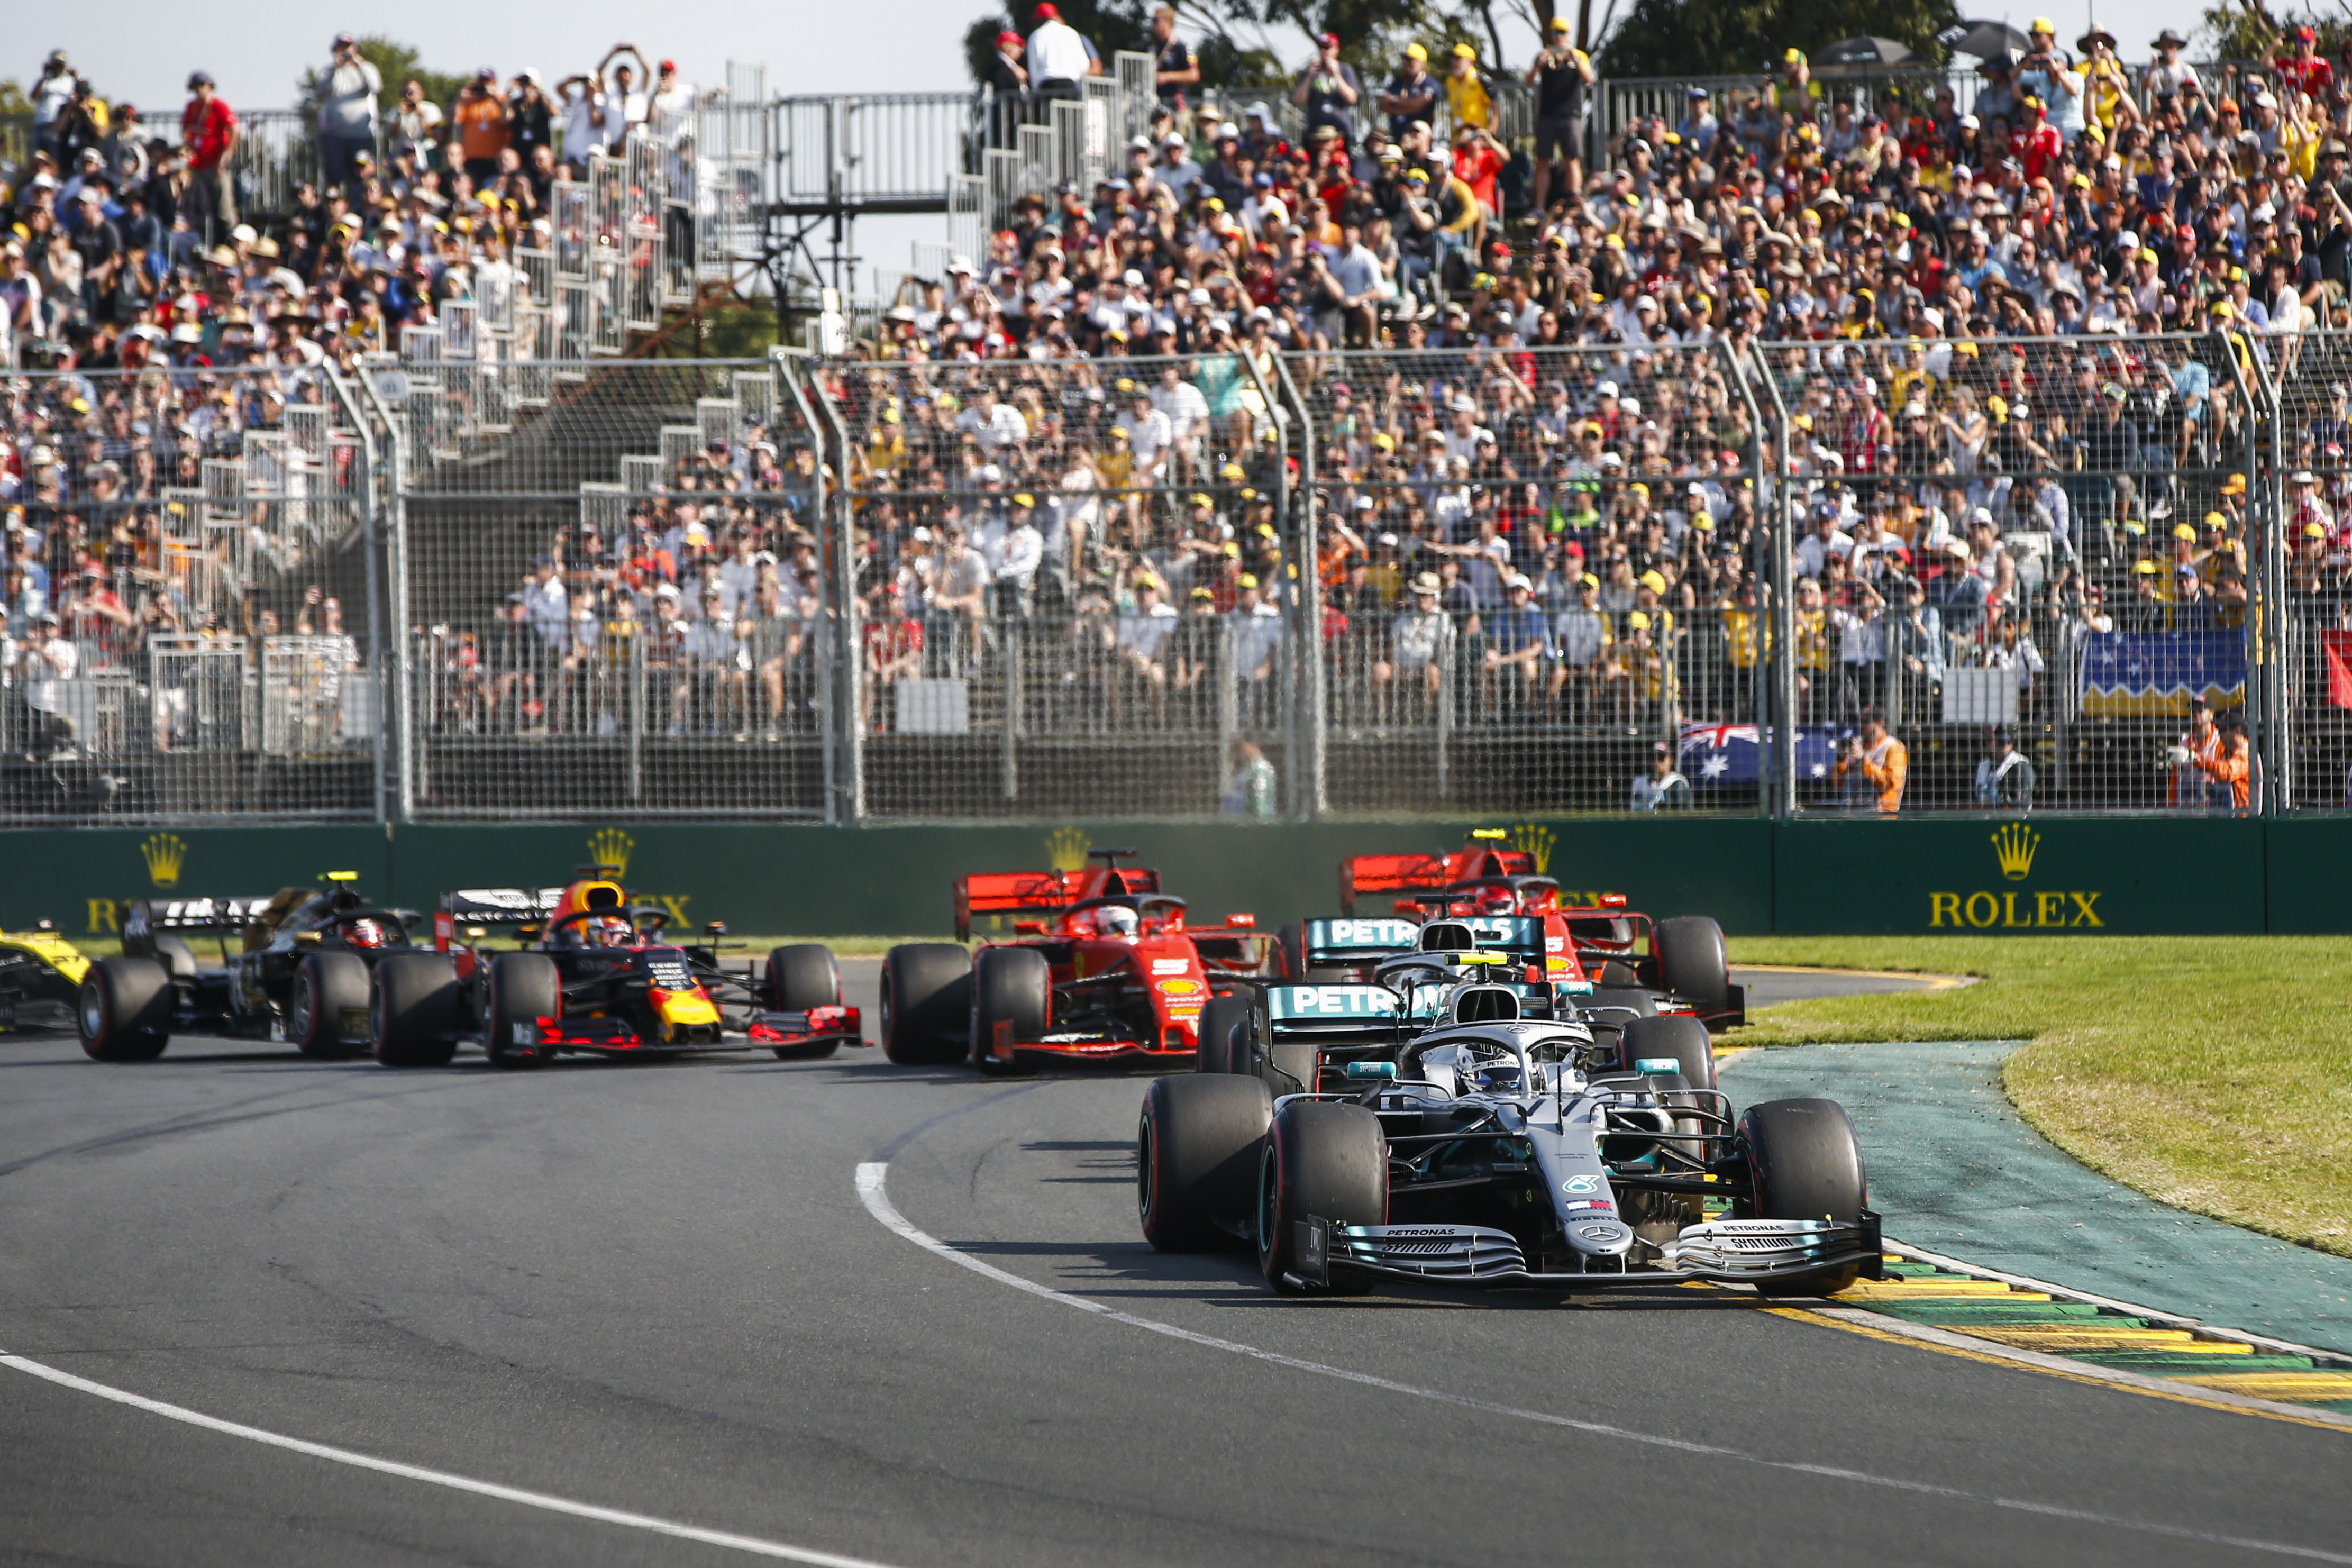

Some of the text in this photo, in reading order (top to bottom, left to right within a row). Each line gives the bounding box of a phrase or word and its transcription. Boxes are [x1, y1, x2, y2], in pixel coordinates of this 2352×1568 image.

[1929, 891, 2105, 928] ROLEX
[1331, 918, 1514, 943] PETRAS
[1293, 986, 1444, 1013] PETRON
[1382, 1243, 1454, 1253] SYNTIUM
[1730, 1238, 1794, 1249] SYNTIUM
